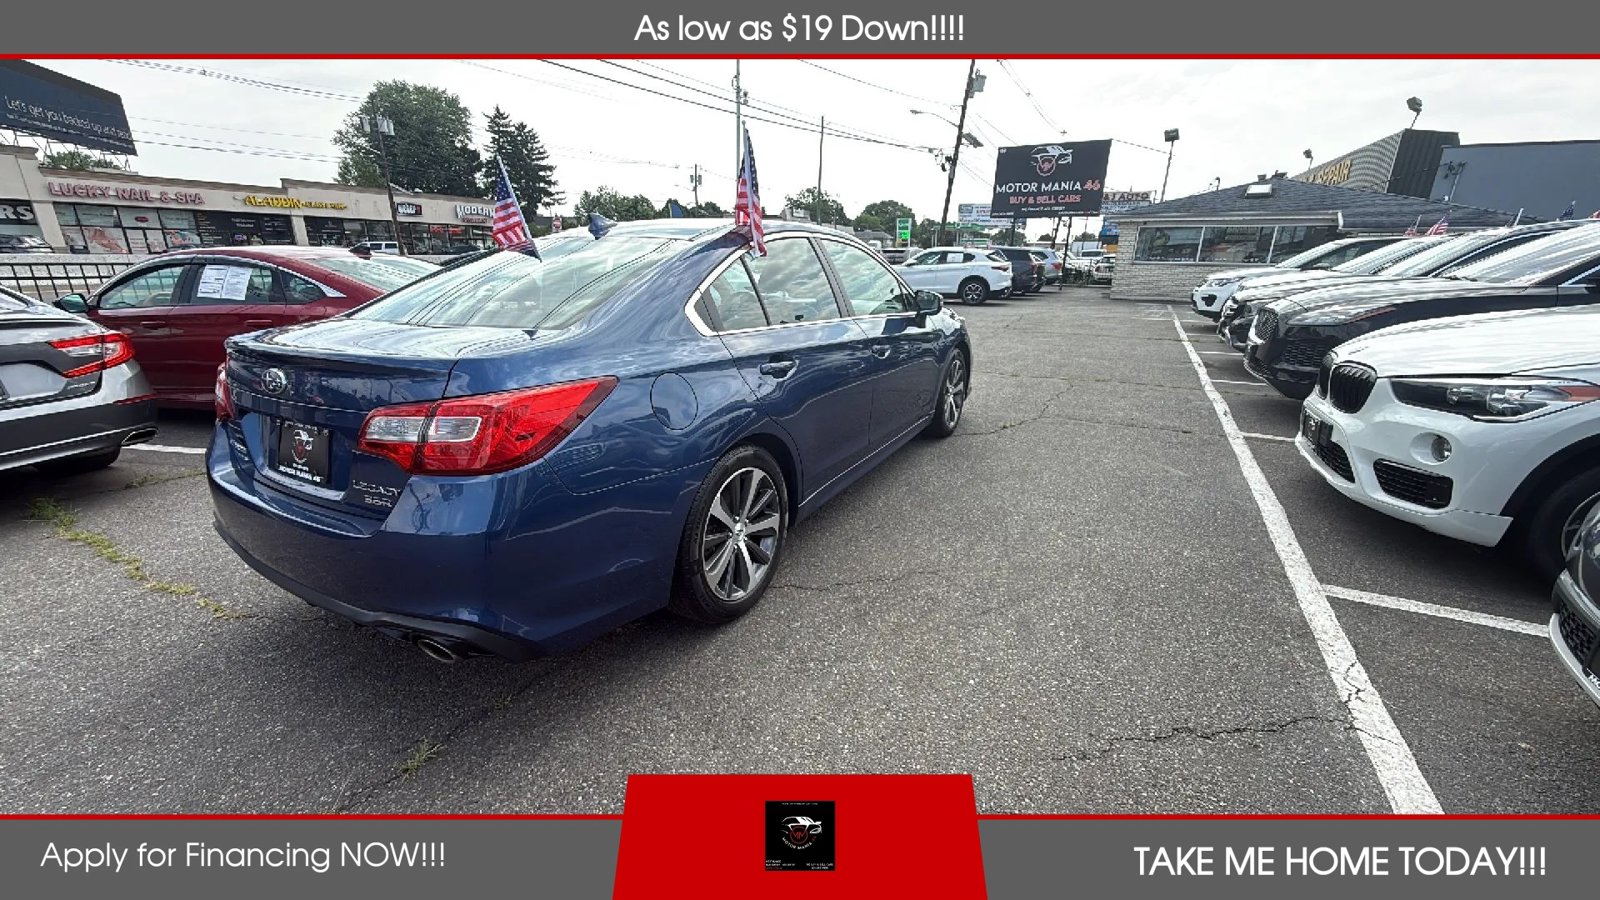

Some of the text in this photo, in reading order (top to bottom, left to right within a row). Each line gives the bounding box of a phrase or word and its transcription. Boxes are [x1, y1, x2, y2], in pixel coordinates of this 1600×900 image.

[4, 95, 26, 112] Let's
[29, 104, 43, 118] get
[45, 109, 62, 122] you
[48, 182, 206, 205] LUCKY NAIL & SPA
[996, 179, 1101, 194] MOTOR MANIA 46
[244, 195, 301, 209] ALADDIN
[1009, 194, 1082, 204] BUY & SELL CARS
[1118, 192, 1149, 201] AUTO
[0, 204, 34, 220] RS
[352, 479, 401, 497] LEGACY
